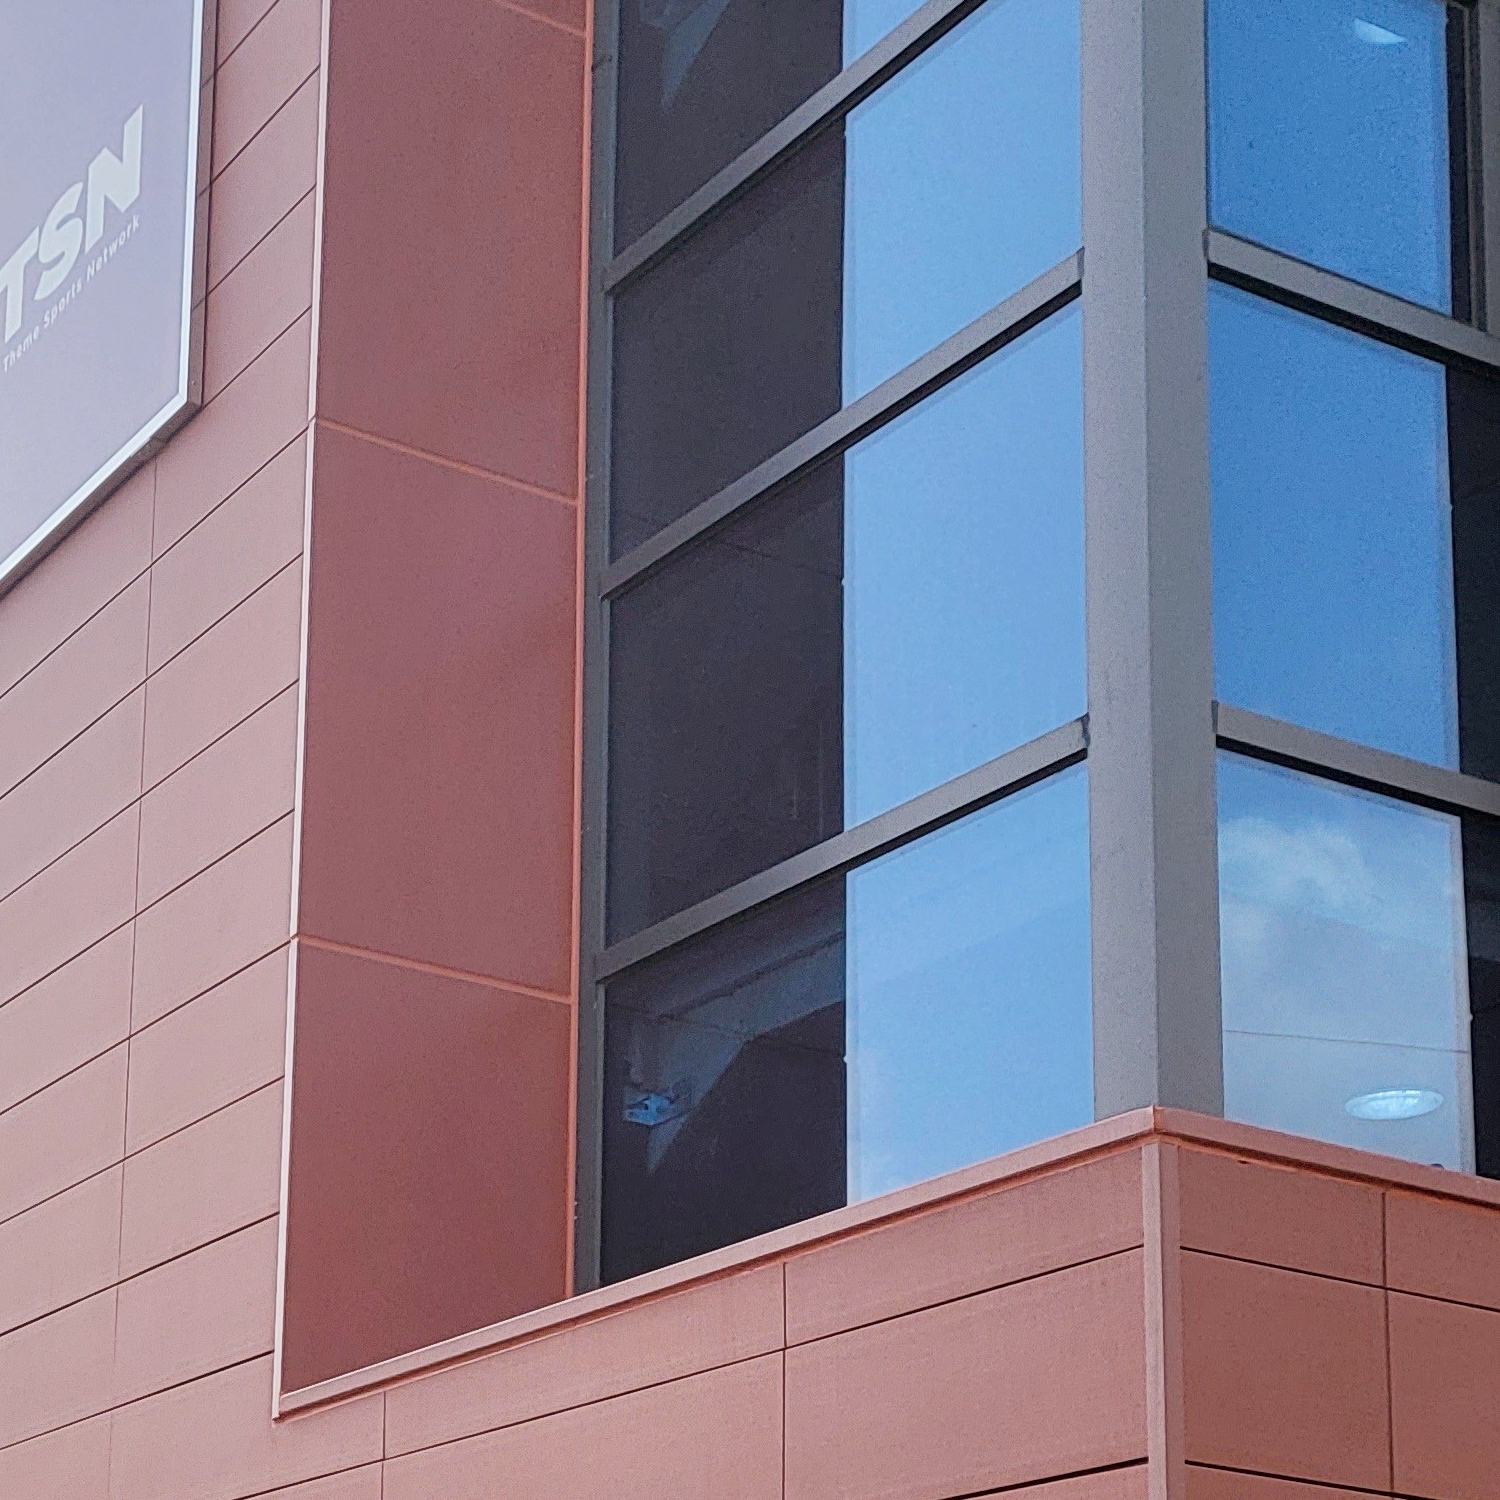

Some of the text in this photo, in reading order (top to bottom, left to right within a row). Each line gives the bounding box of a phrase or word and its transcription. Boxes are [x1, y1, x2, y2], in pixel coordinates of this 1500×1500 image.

[3, 214, 140, 373] Theme Sports Network
